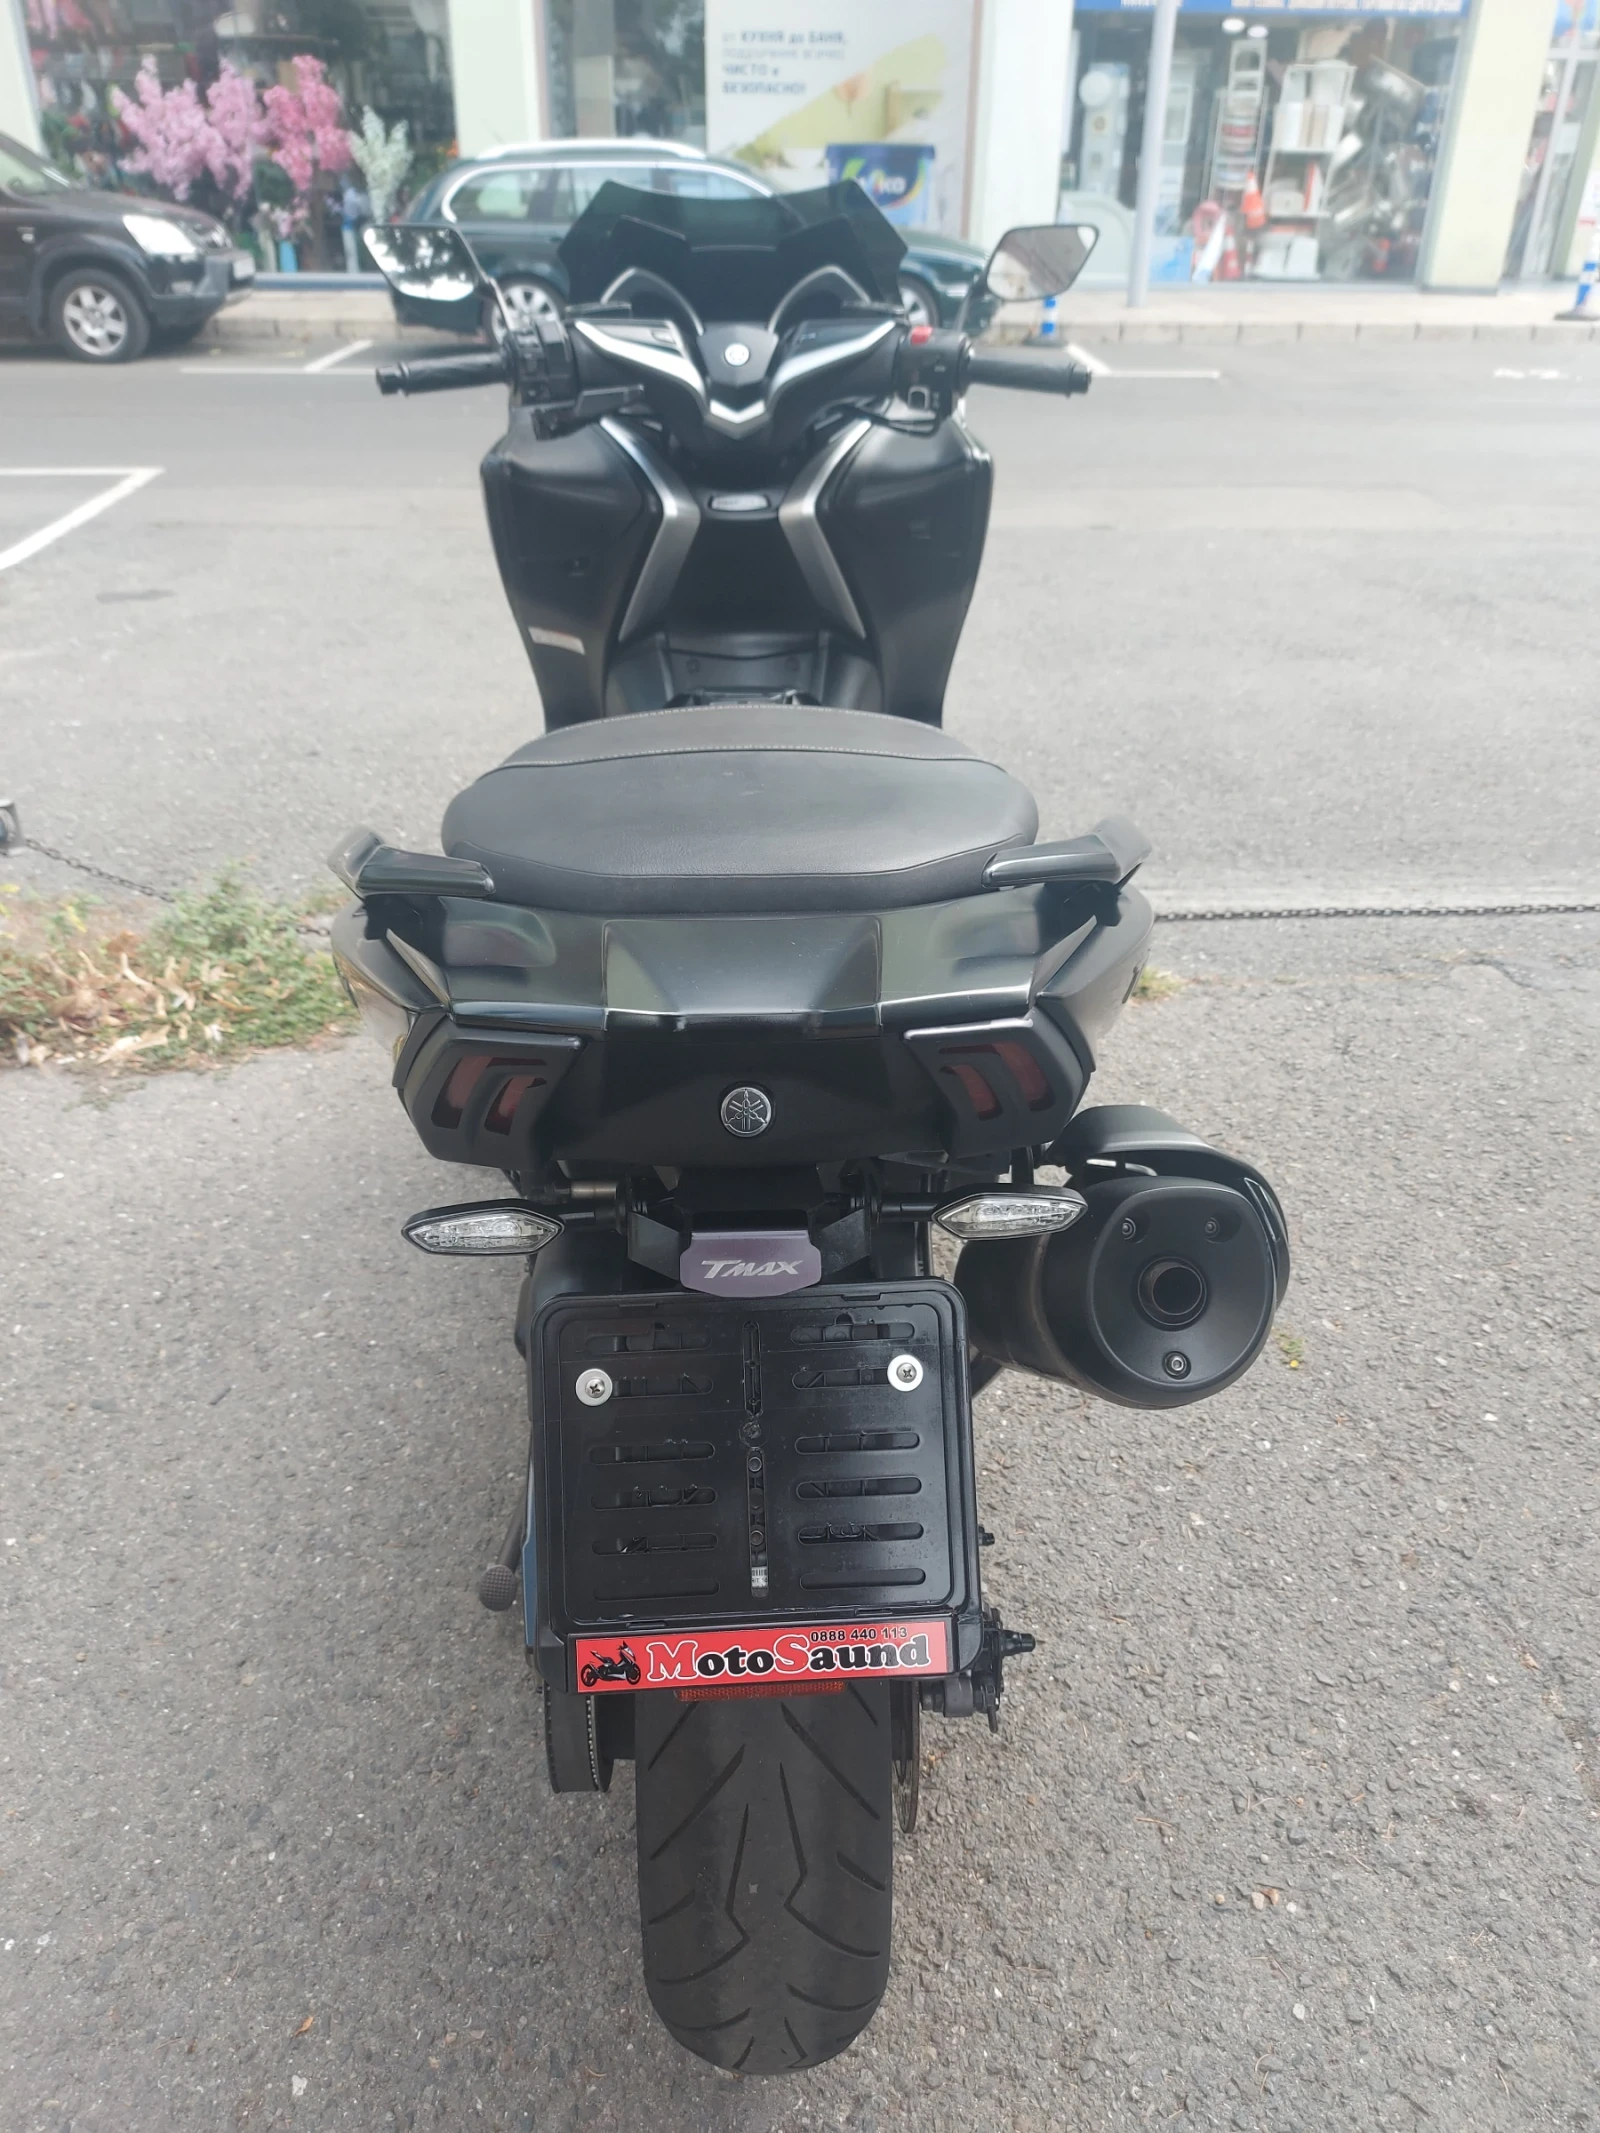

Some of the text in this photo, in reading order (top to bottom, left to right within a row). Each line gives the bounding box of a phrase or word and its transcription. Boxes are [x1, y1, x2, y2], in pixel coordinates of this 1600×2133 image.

[701, 1259, 803, 1279] TMAX
[811, 1626, 908, 1642] 0888 440 113
[646, 1634, 930, 1681] MotoSaund
